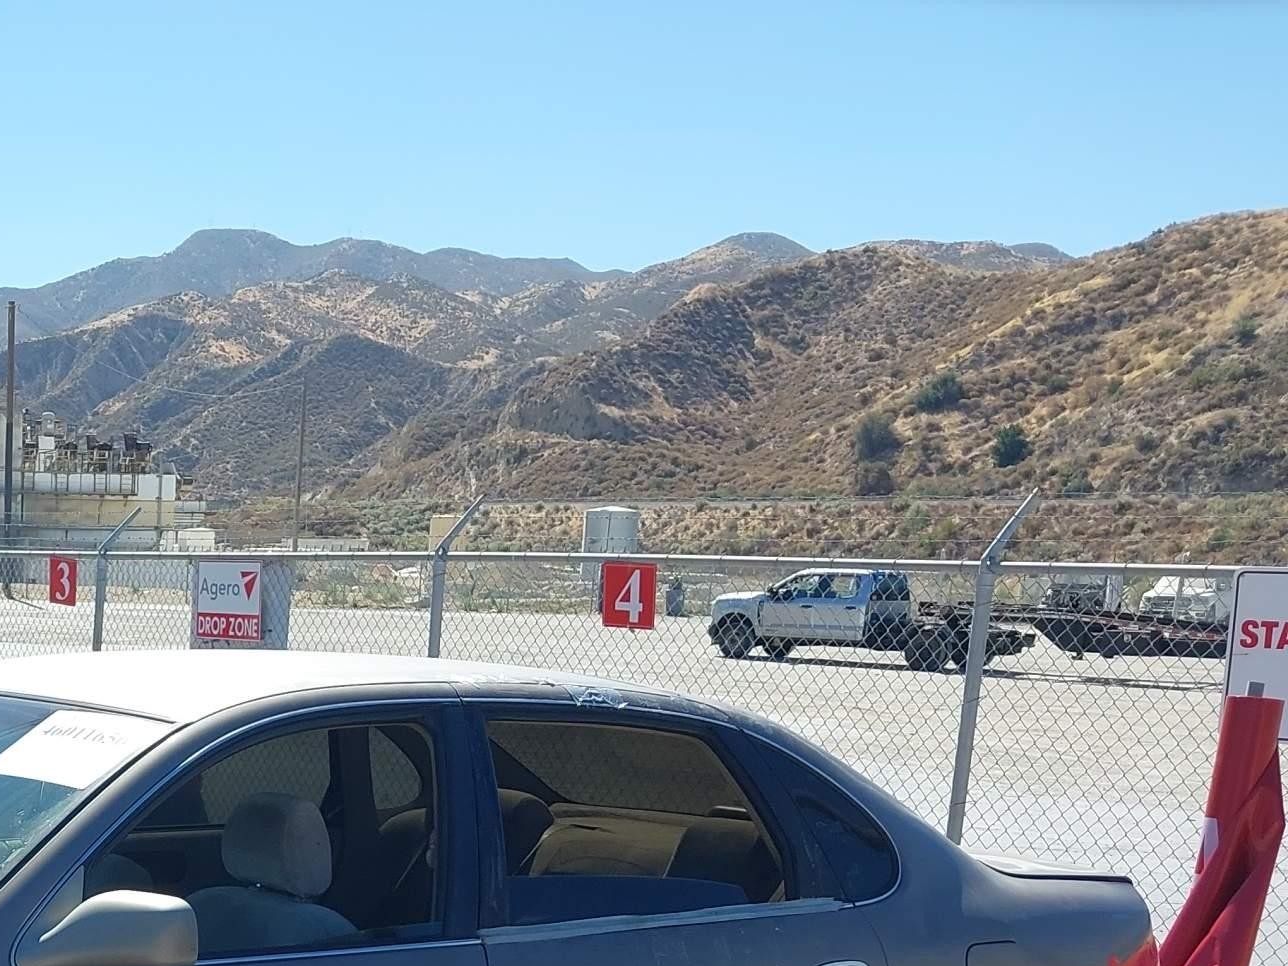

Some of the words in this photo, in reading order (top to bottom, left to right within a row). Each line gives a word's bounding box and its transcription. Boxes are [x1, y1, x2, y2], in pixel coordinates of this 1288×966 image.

[55, 561, 70, 601] 3
[200, 577, 240, 600] Agero
[614, 569, 643, 623] 4
[198, 615, 227, 635] DROP
[228, 617, 258, 637] ZONE
